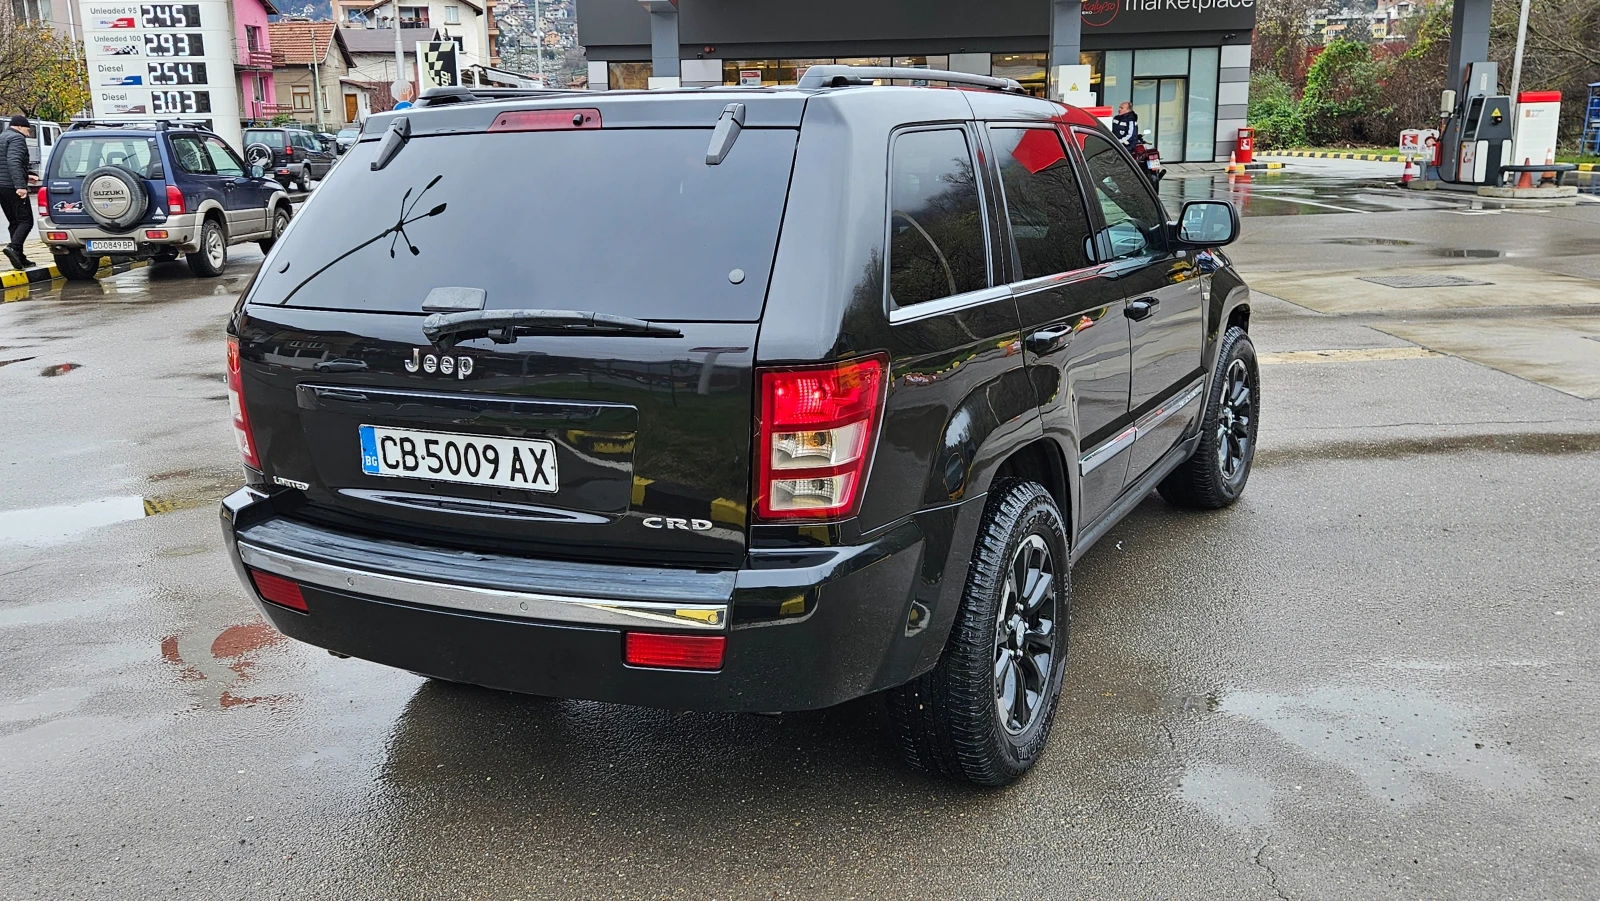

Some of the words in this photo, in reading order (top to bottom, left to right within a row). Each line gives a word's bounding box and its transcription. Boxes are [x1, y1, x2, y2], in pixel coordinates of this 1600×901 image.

[142, 4, 186, 28] 2.45
[145, 33, 190, 57] 2.93
[98, 64, 124, 72] Diesel
[149, 62, 193, 85] 2.54
[153, 91, 197, 113] 3.03
[404, 347, 473, 379] Jeep
[365, 455, 378, 467] BG
[510, 446, 550, 486] AX
[642, 517, 713, 531] CRD
